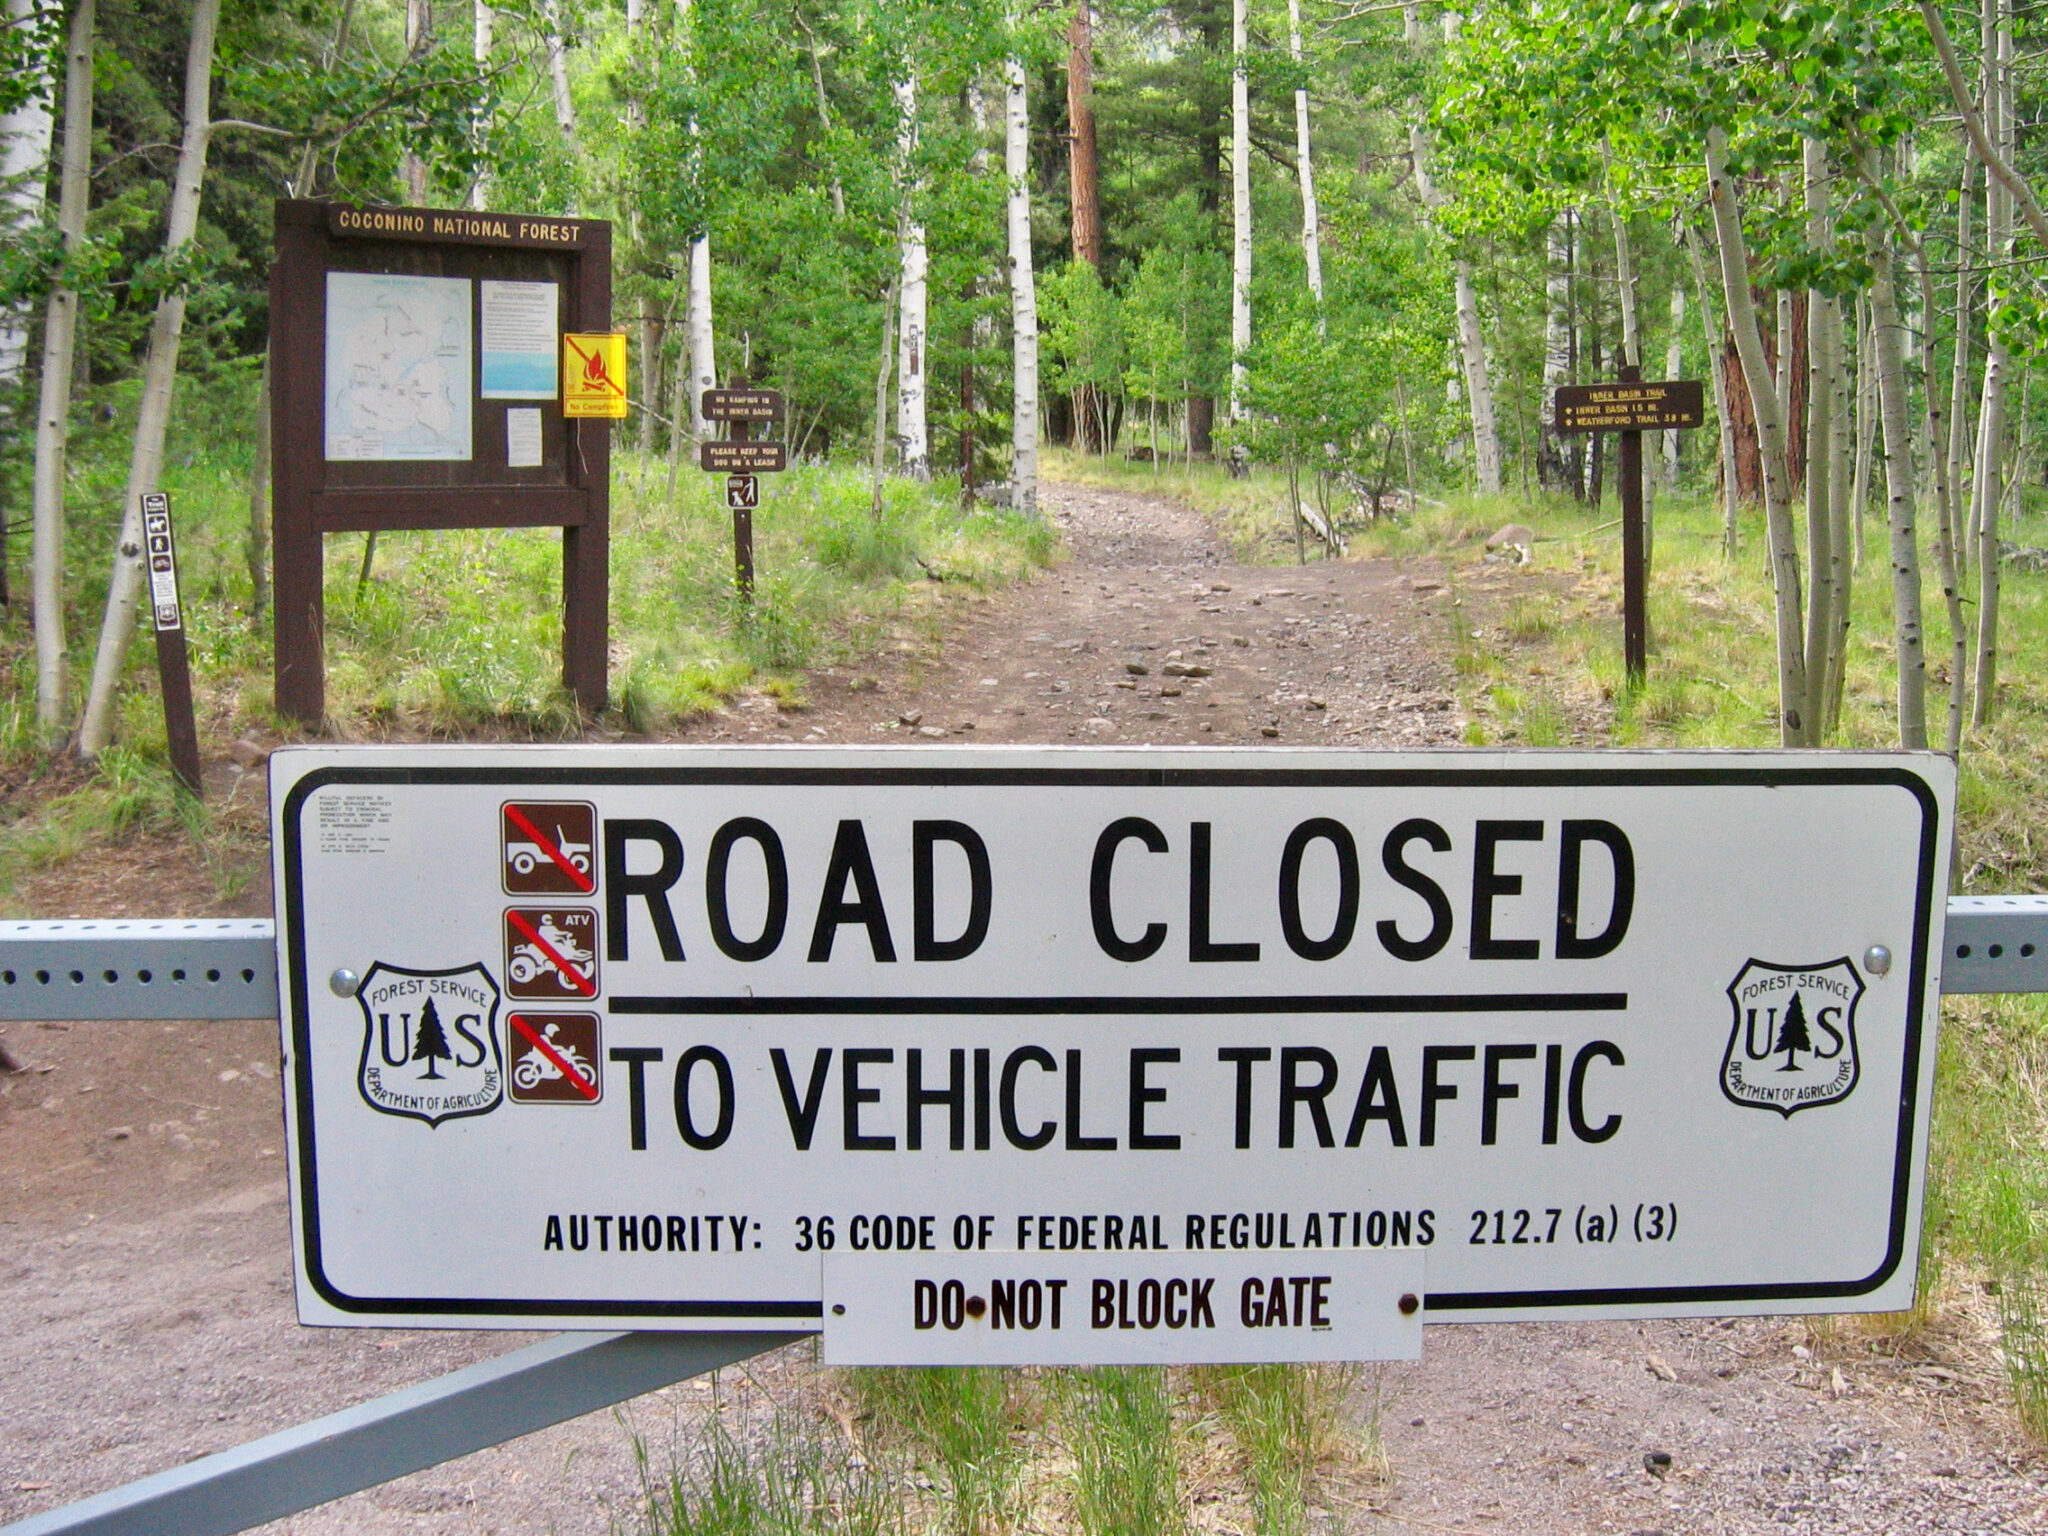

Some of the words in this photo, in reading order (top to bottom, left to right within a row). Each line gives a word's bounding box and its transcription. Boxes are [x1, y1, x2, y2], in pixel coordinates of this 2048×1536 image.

[340, 211, 424, 232] COCONINO
[434, 218, 511, 239] NATIONAL
[520, 223, 580, 242] FOREST
[729, 396, 758, 404] CAMPING
[1646, 388, 1667, 397] TRAIL
[712, 408, 724, 416] THE
[752, 408, 773, 416] BASIN
[1576, 415, 1631, 426] WEATHERFORD
[1636, 414, 1659, 423] TRAIL
[710, 447, 737, 455] PLEASE
[740, 447, 758, 455] KEEP
[762, 447, 779, 455] YOUR
[754, 458, 776, 466] LEASH
[604, 817, 993, 962] ROAD
[1090, 817, 1635, 962] CLOSED
[565, 915, 590, 927] ATV
[372, 979, 424, 1007] FOREST
[430, 979, 486, 1008] SERVICE
[1742, 974, 1794, 1003] FOREST
[1798, 974, 1849, 1000] SERVICE
[367, 1067, 424, 1110] DEPARTMENT
[427, 1097, 440, 1110] OF
[442, 1068, 497, 1110] AGRICULTURE
[1729, 1061, 1781, 1100] DEPARTMENT
[1782, 1088, 1795, 1101] OF
[1797, 1058, 1851, 1100] AGRICULTURE
[609, 1045, 735, 1151] TO
[769, 1046, 1181, 1151] VEHICLE
[1218, 1042, 1625, 1150] TRAFFIC
[545, 1215, 762, 1252] AUTHORITY:
[796, 1215, 835, 1251] 36
[850, 1215, 936, 1250] CODE
[954, 1215, 995, 1250] OF
[1018, 1215, 1169, 1250] FEDERAL
[1185, 1210, 1435, 1250] REGULATIONS
[1470, 1209, 1562, 1245] 212.7
[1576, 1205, 1618, 1244] (a)
[1634, 1205, 1677, 1242] (3)
[915, 1280, 965, 1330] DO
[991, 1280, 1067, 1330] NOT
[1092, 1279, 1215, 1329] BLOCK
[1241, 1277, 1331, 1328] GATE
